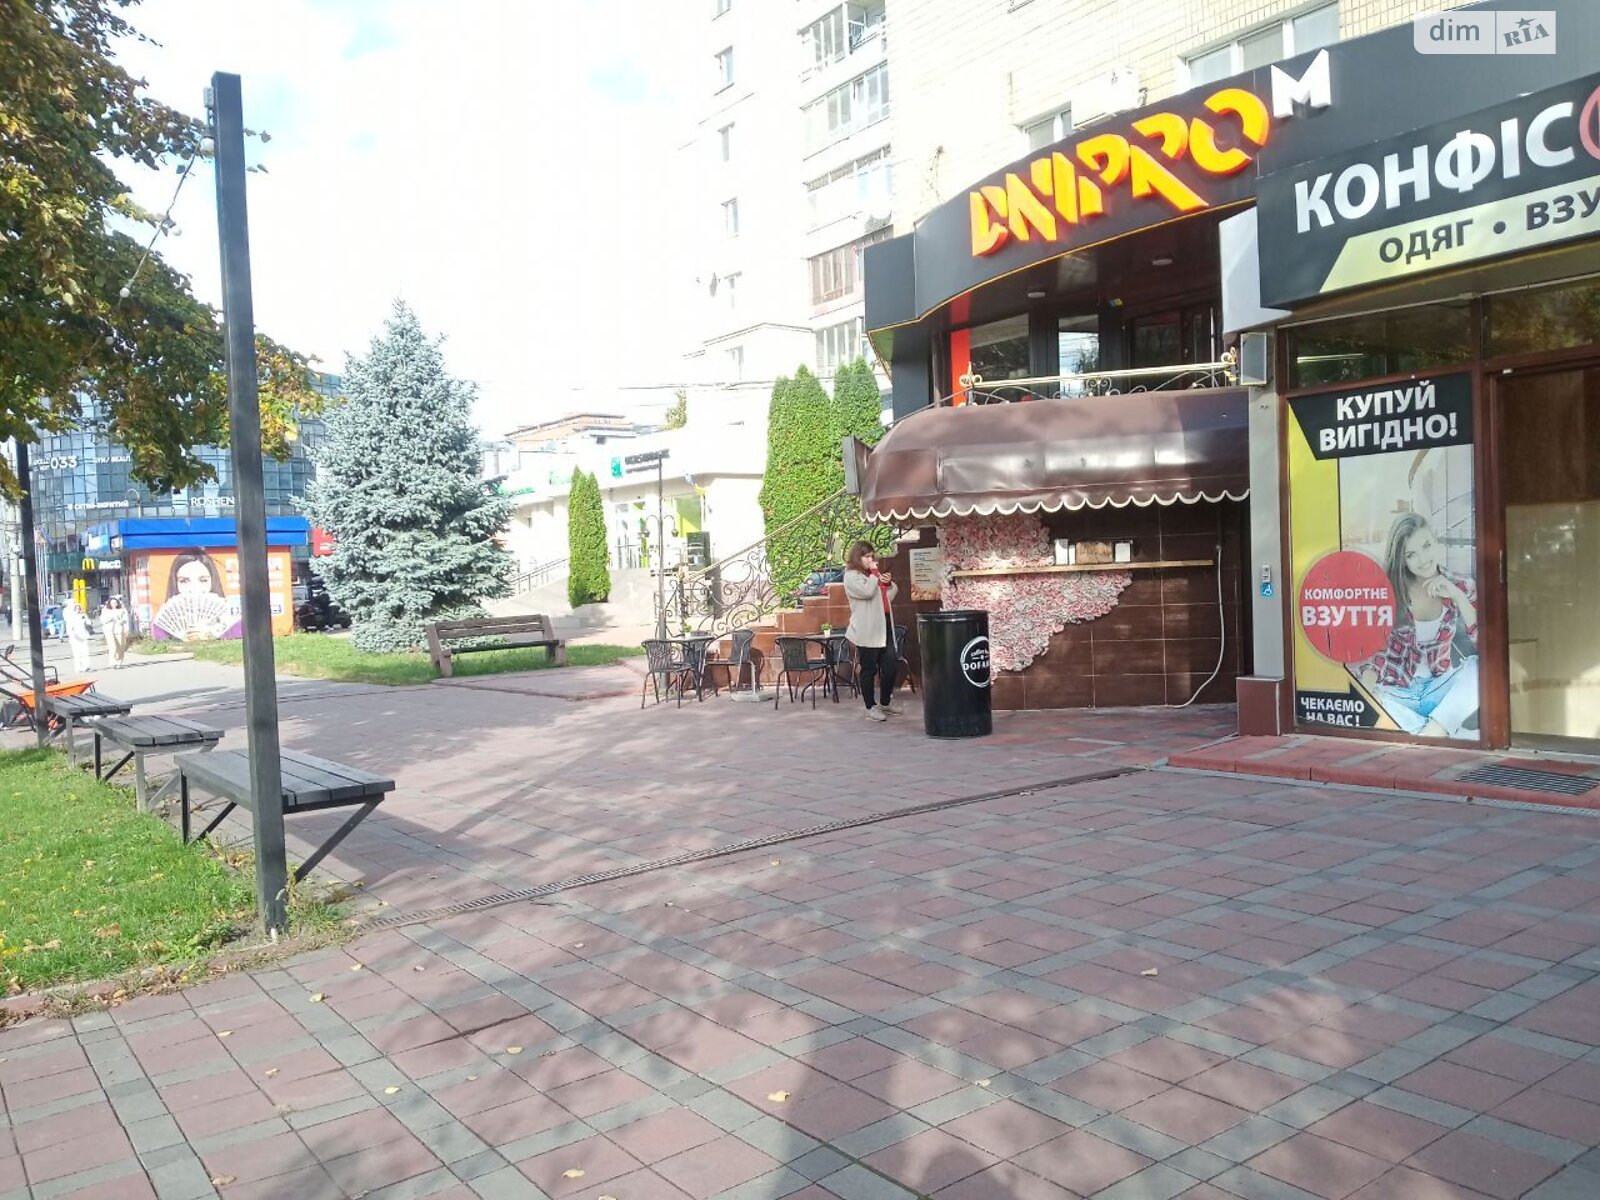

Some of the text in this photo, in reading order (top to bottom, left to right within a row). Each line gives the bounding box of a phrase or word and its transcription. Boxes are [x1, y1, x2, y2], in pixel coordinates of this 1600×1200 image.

[1379, 218, 1474, 265] ОДЯГ
[1336, 380, 1436, 421] КУПУЙ
[1319, 412, 1458, 452] ВИГІДНО!
[50, 455, 78, 470] 033
[191, 496, 235, 507] ROSHEN
[1304, 588, 1388, 600] КОМФОРТНЕ
[1302, 605, 1394, 627] ВЗУТТЯ
[1300, 697, 1365, 713] ЧЕКАЄМО
